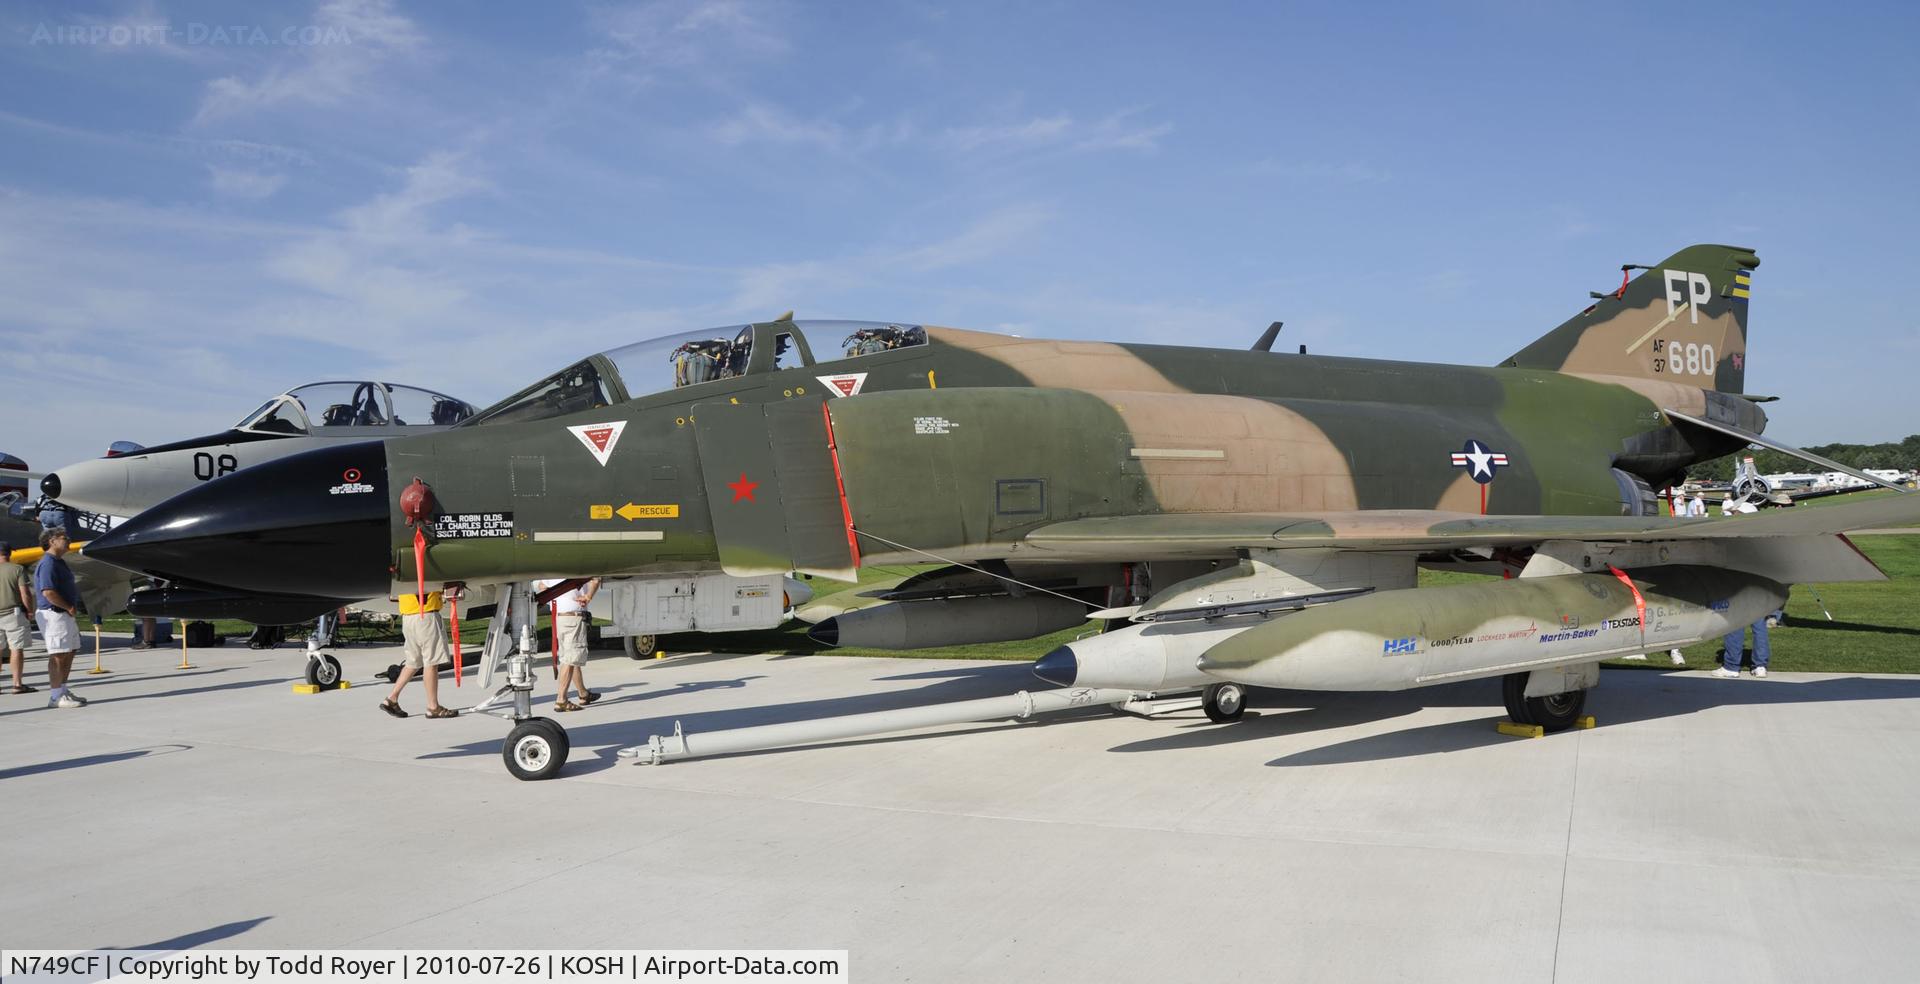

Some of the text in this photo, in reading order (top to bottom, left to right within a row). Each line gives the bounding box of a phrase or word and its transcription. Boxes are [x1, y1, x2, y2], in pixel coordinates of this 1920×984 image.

[1664, 269, 1711, 324] FP
[1653, 339, 1665, 353] AF
[1669, 341, 1715, 376] 680
[1654, 359, 1666, 373] 37
[193, 451, 238, 481] 08
[458, 514, 481, 522] ROBIN
[483, 513, 503, 521] OLDS
[640, 507, 671, 515] RESCUE
[448, 522, 481, 530] CHARLES
[483, 521, 513, 529] CLIFTON
[461, 529, 479, 537] TOM
[480, 528, 511, 537] CHILTON
[1608, 617, 1641, 629] TEXSTARS
[1477, 633, 1506, 642] LOCKHEED
[1539, 628, 1599, 643] Martin-Baker
